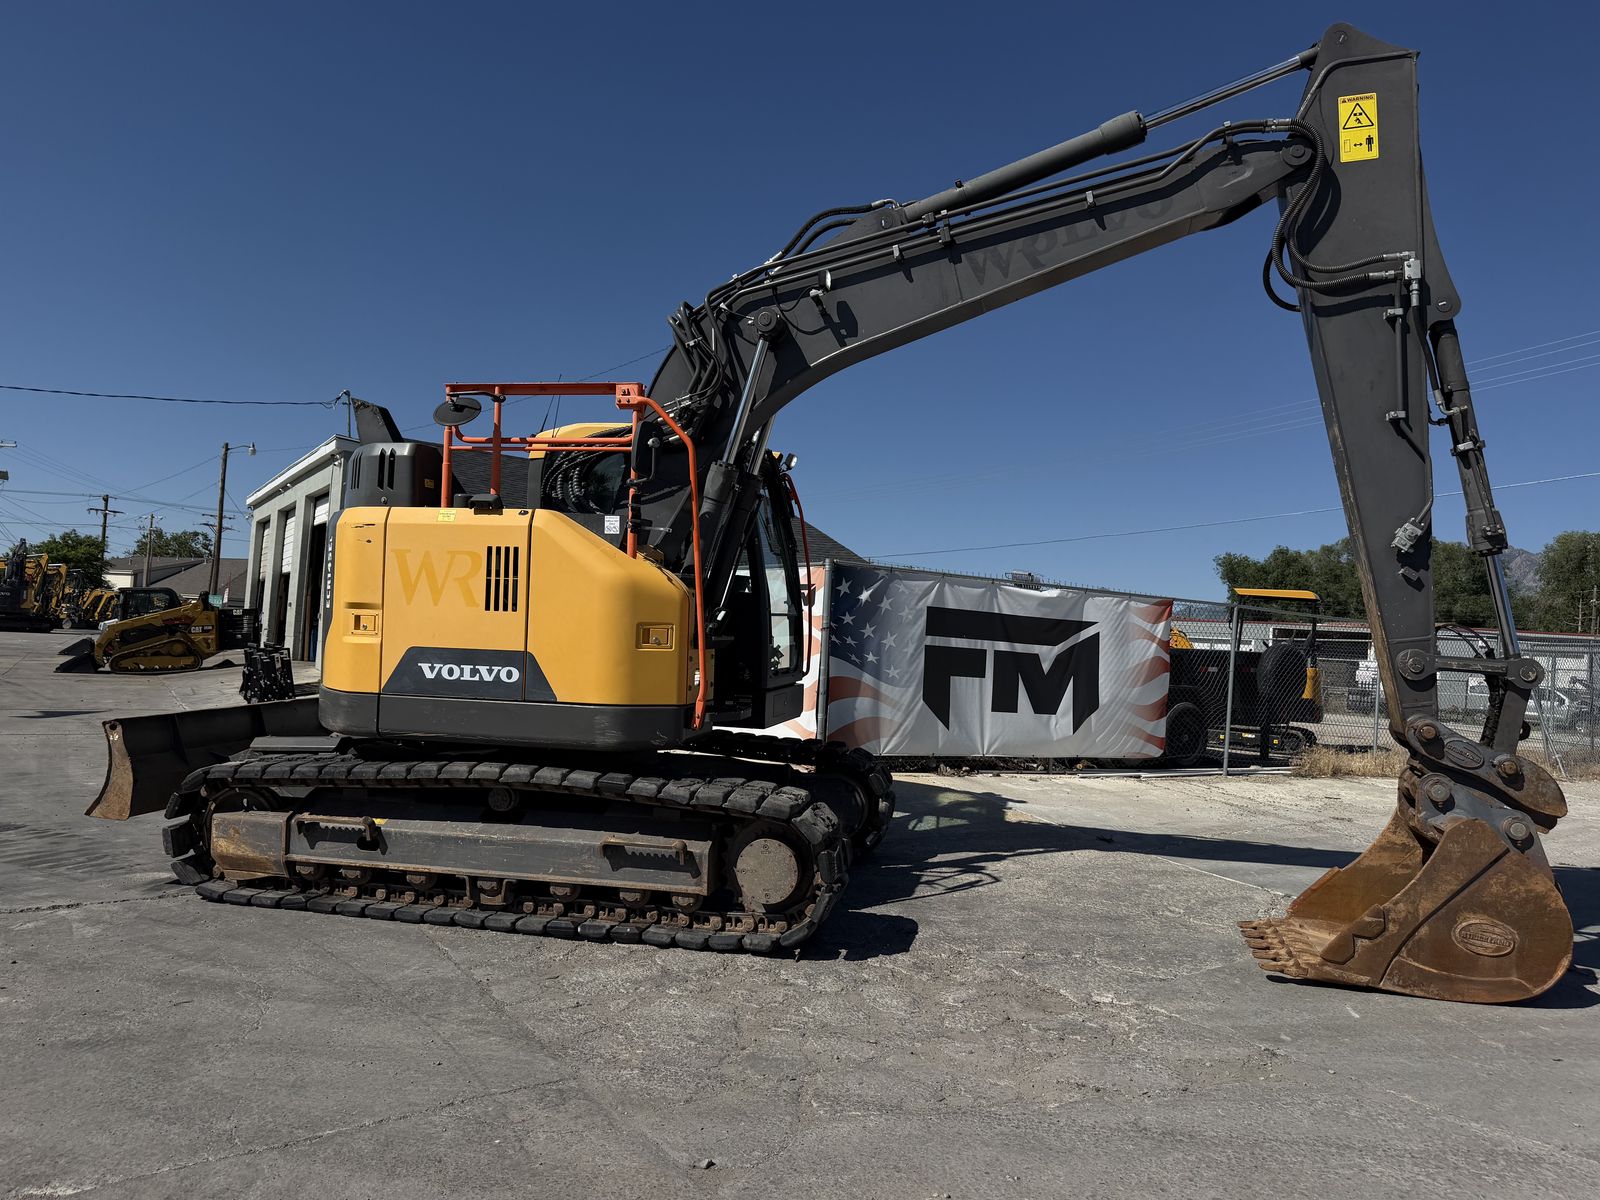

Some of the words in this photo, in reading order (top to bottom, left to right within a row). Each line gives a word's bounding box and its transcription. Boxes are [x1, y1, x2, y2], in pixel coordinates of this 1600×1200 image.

[390, 548, 483, 608] WR
[418, 662, 520, 683] VOLVO
[922, 606, 1100, 735] FM
